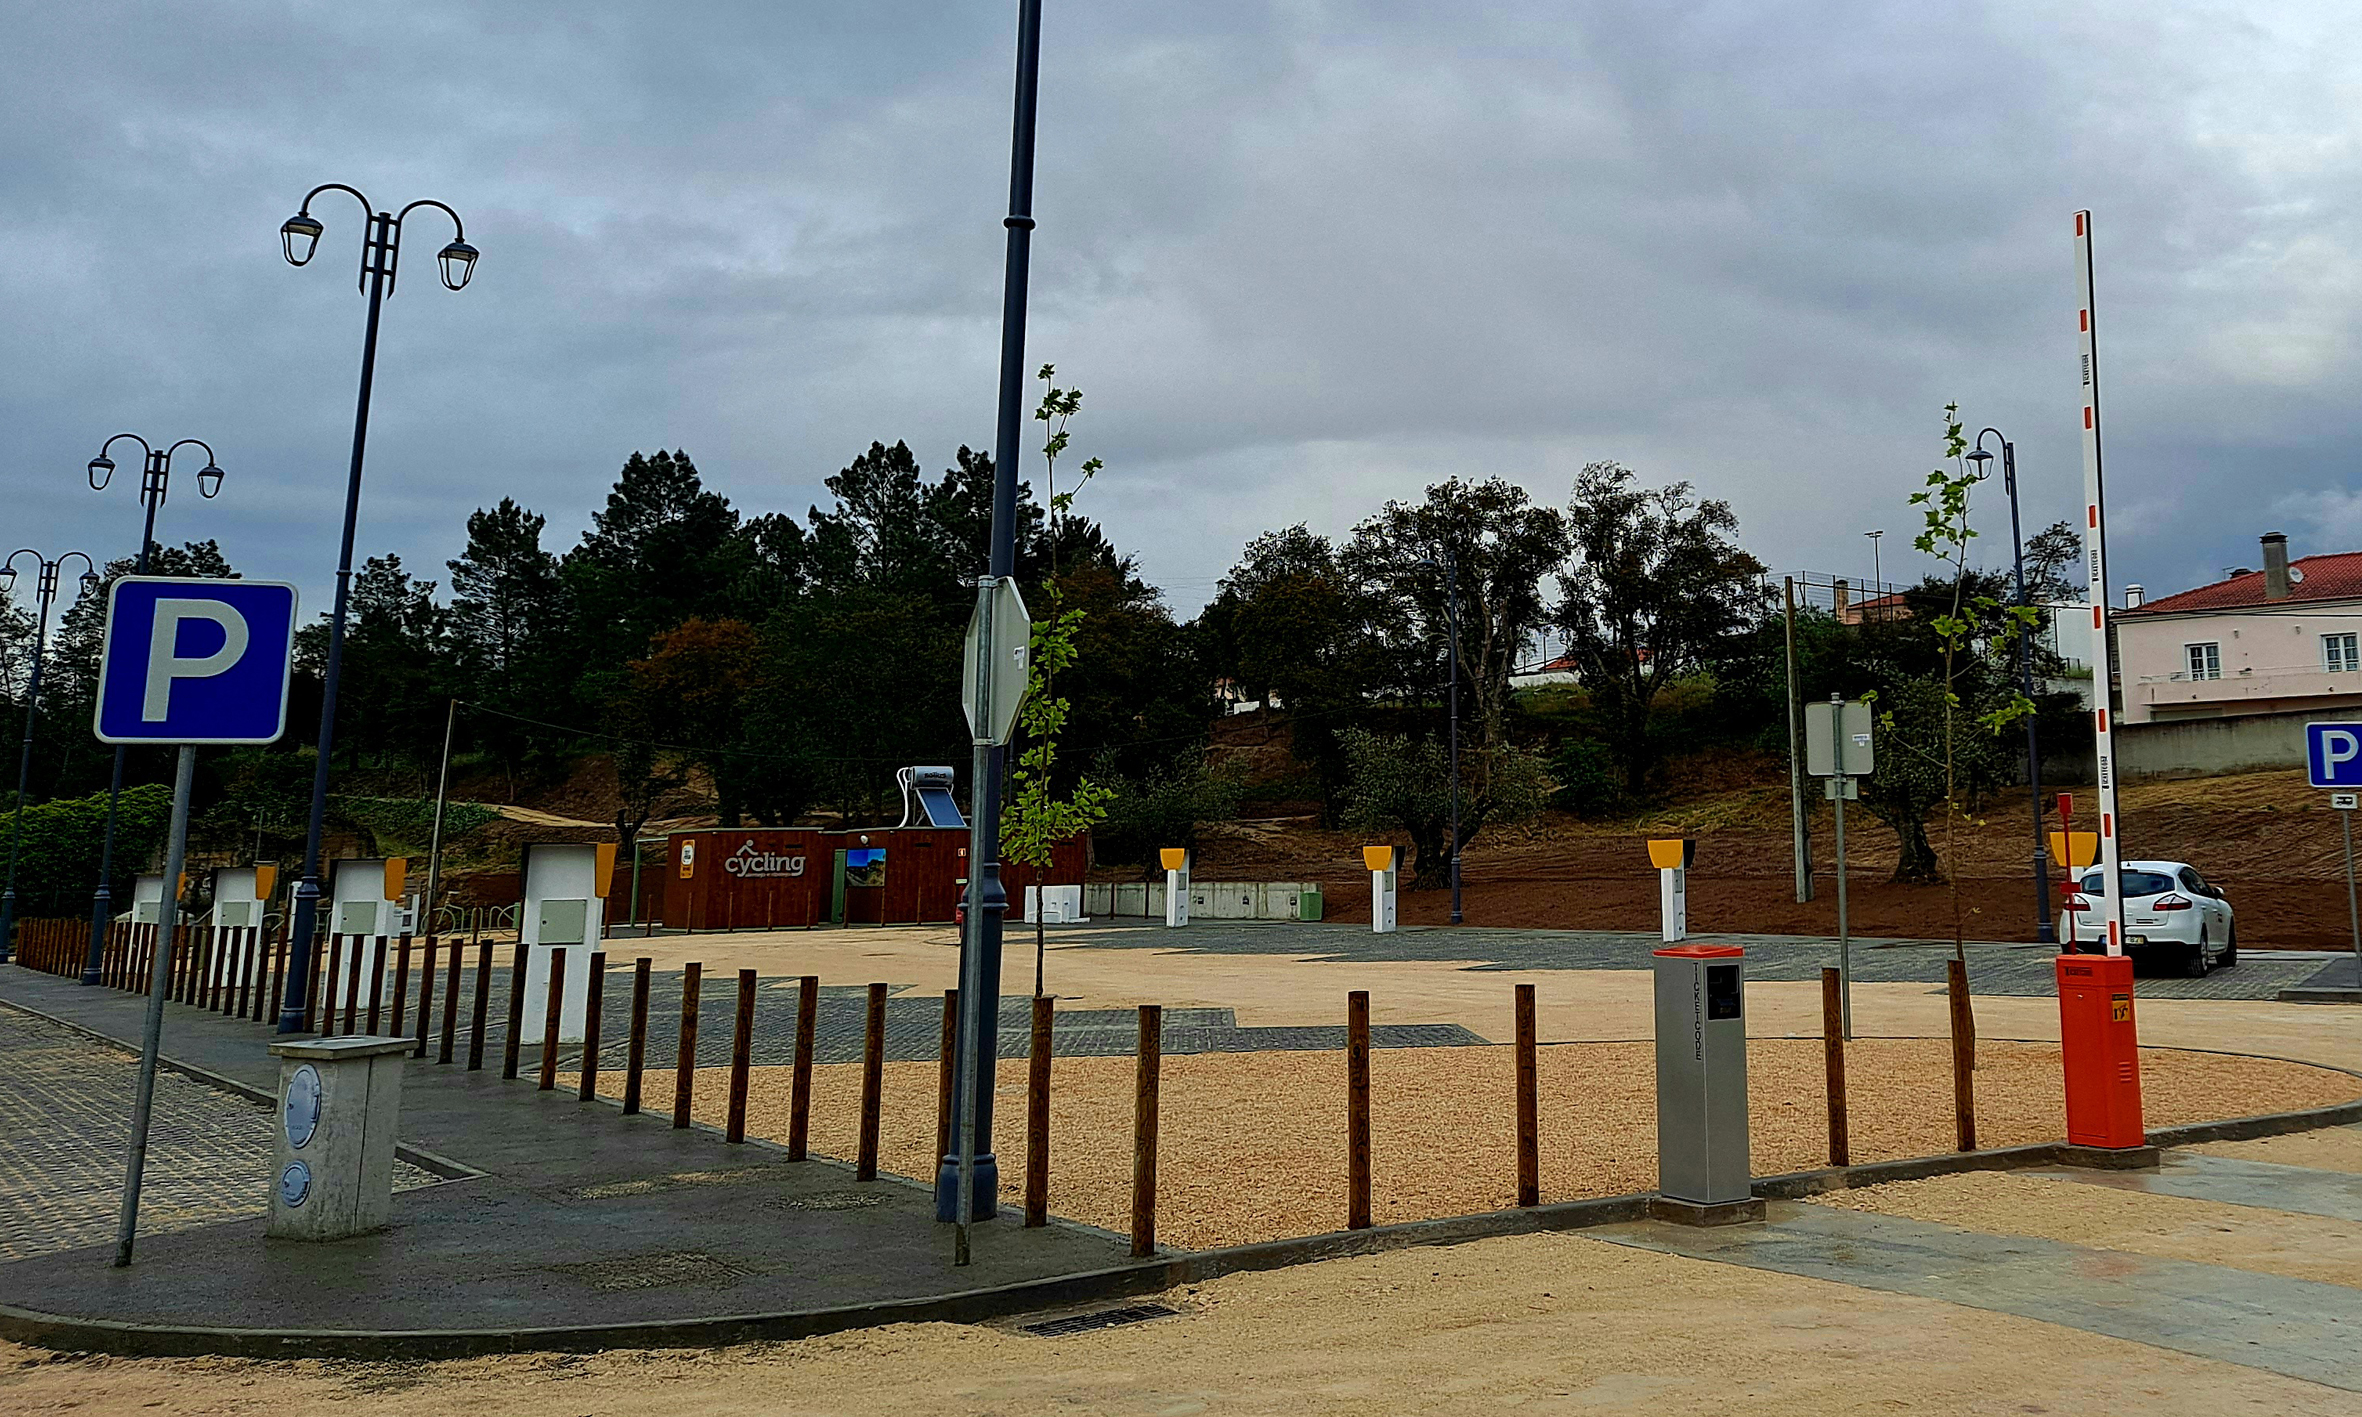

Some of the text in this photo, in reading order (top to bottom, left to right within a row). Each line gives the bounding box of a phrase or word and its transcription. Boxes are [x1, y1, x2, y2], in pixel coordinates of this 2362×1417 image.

[141, 597, 250, 722] P
[2321, 730, 2359, 779] P
[724, 851, 806, 878] cycling
[1692, 962, 1702, 1061] TICKETCODE
